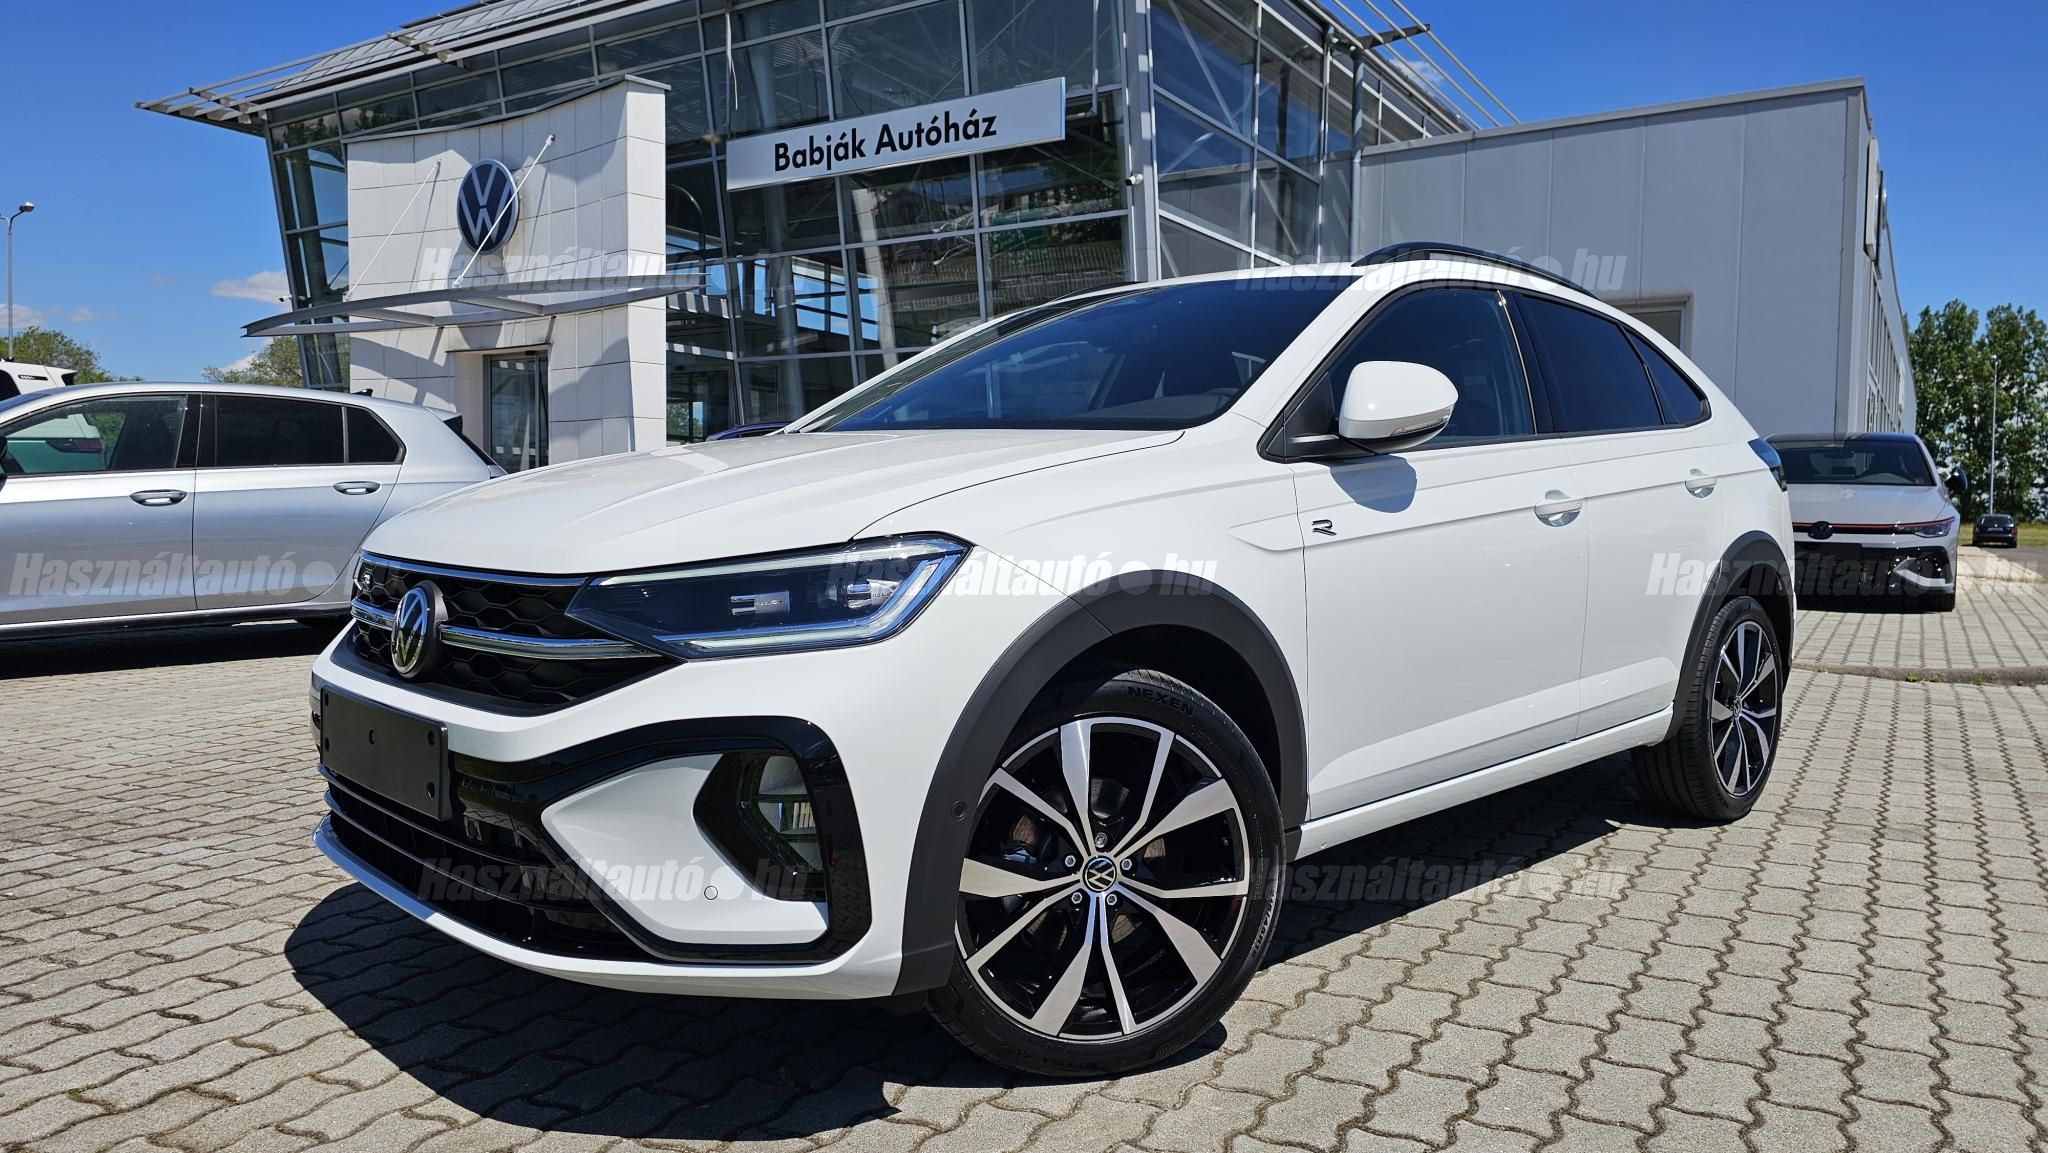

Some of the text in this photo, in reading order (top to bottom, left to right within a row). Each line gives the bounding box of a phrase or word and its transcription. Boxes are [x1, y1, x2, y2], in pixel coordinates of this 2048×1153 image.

[774, 108, 998, 171] Babják Autóház
[1127, 685, 1194, 717] NEXEN
